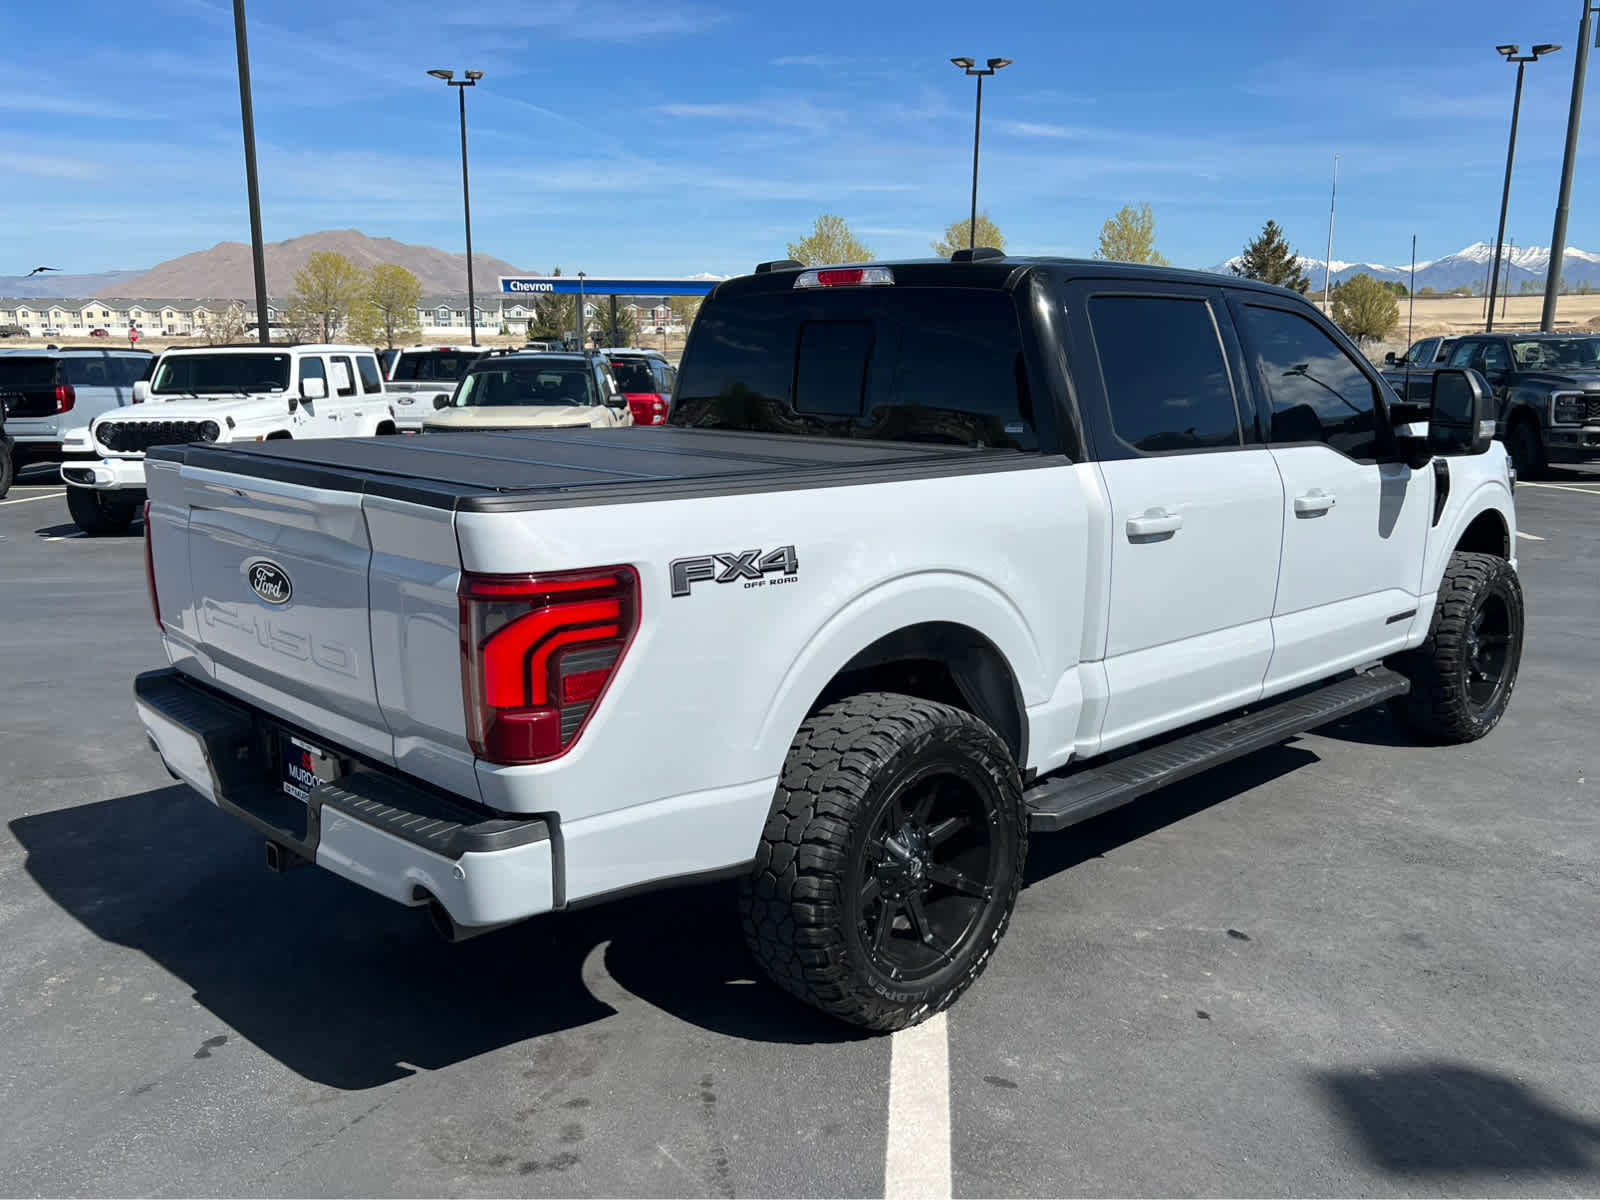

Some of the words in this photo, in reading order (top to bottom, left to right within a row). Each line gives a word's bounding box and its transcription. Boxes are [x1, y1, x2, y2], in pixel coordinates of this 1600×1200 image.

[510, 280, 553, 292] Chevron
[254, 566, 283, 598] Ford
[669, 545, 799, 598] FX4
[744, 580, 766, 589] OFF
[769, 576, 798, 586] ROAD
